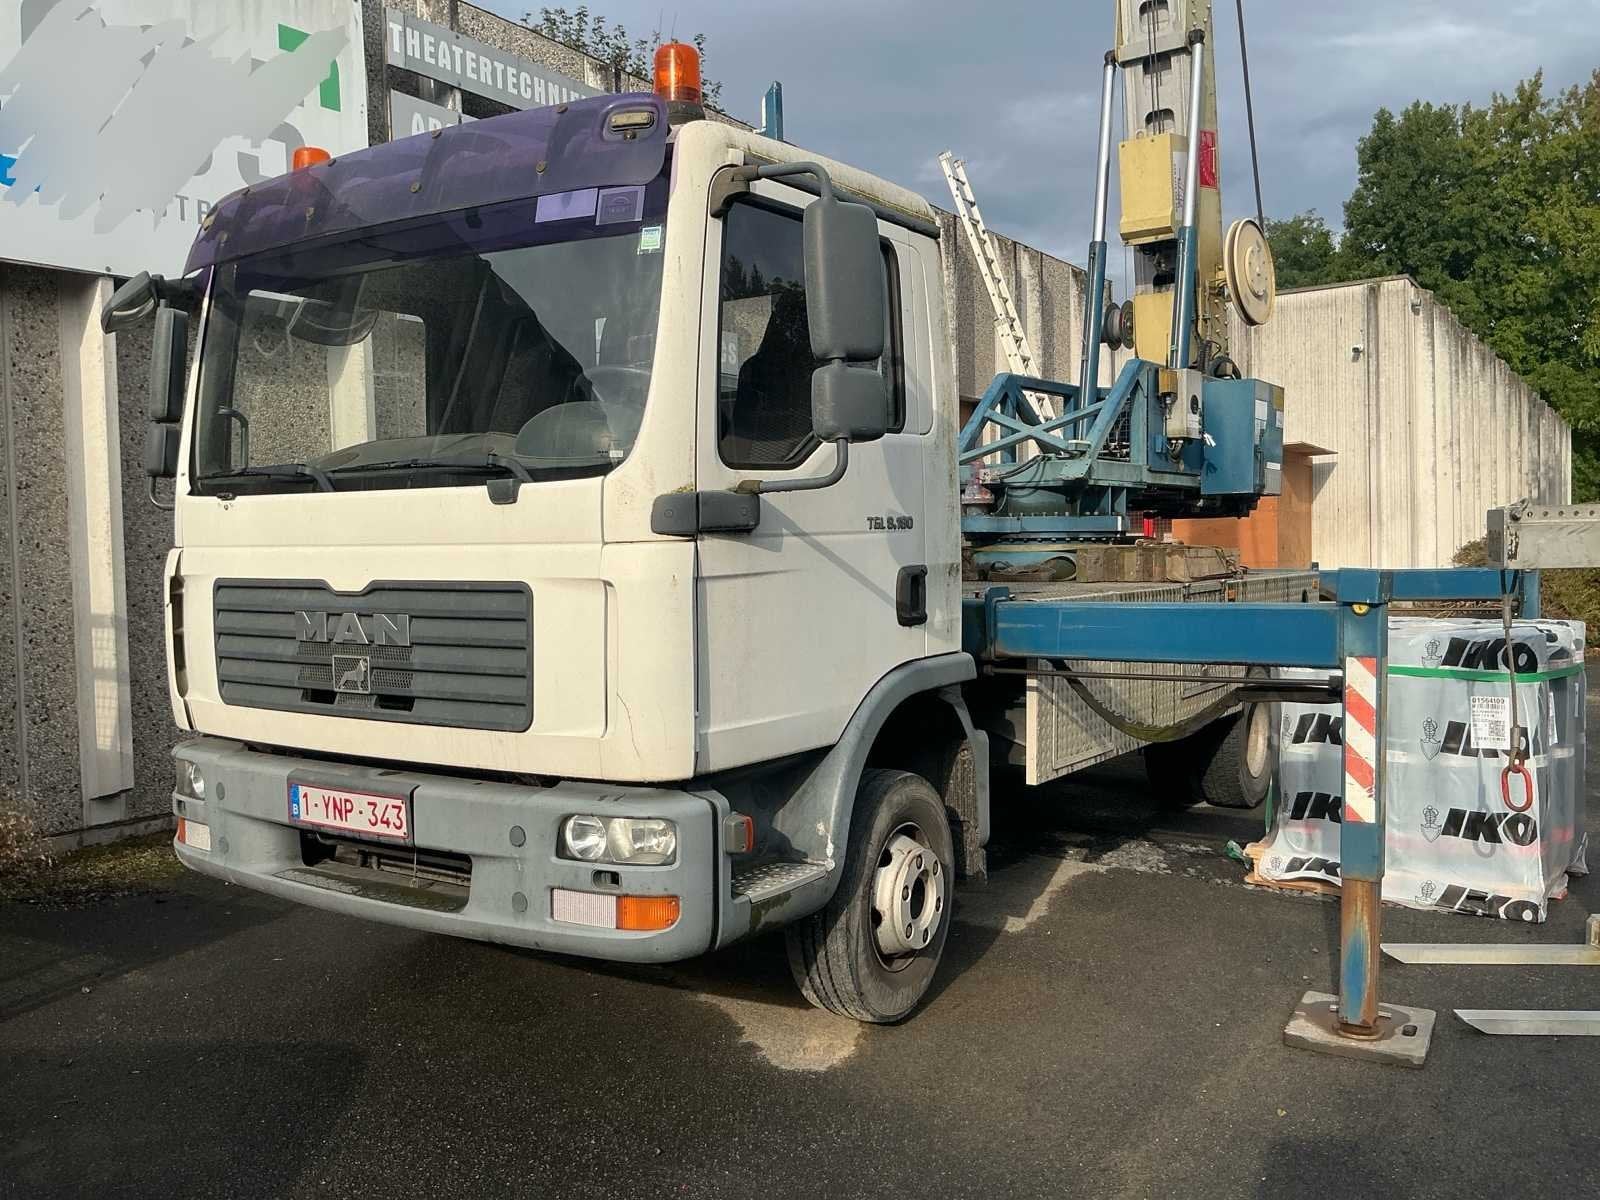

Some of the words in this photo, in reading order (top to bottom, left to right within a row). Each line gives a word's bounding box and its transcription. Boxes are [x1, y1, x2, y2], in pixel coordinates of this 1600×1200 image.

[389, 21, 587, 106] THEATERTECHNI
[295, 611, 411, 646] MAN
[1440, 637, 1538, 674] IKO
[1292, 712, 1342, 746] IK
[292, 803, 299, 815] B
[302, 792, 403, 830] 1-YNP-343
[1290, 791, 1342, 824] IK
[1441, 807, 1538, 847] IKO
[1285, 856, 1341, 878] IK
